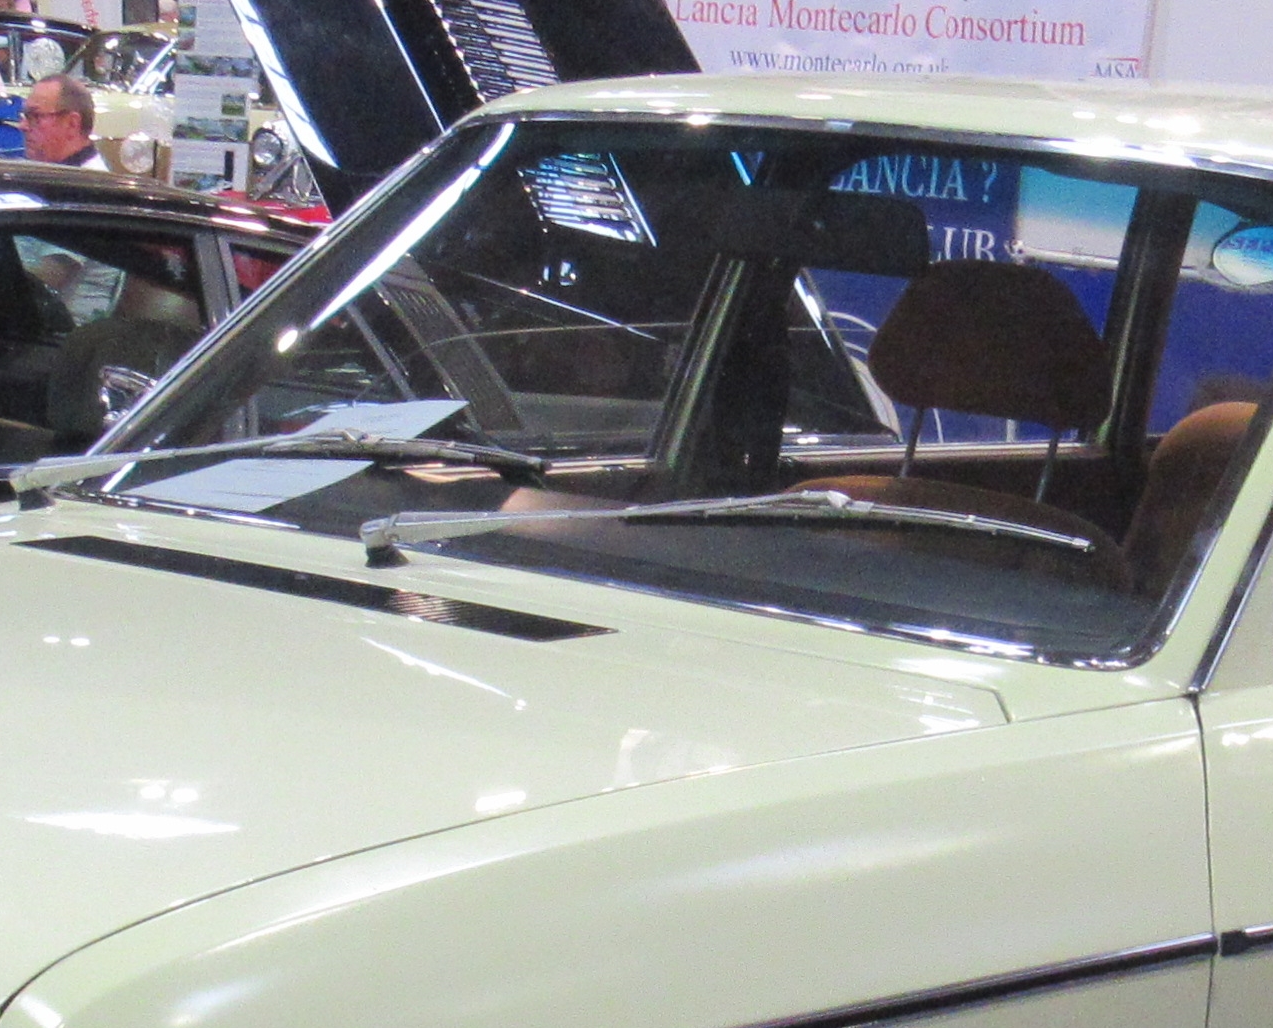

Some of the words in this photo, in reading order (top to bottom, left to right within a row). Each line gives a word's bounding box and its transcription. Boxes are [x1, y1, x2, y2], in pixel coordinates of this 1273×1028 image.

[676, 0, 758, 26] Lancia
[769, 0, 916, 37] Montecarlo
[925, 5, 1086, 46] Consortium
[730, 50, 949, 73] www.montecarlooruk
